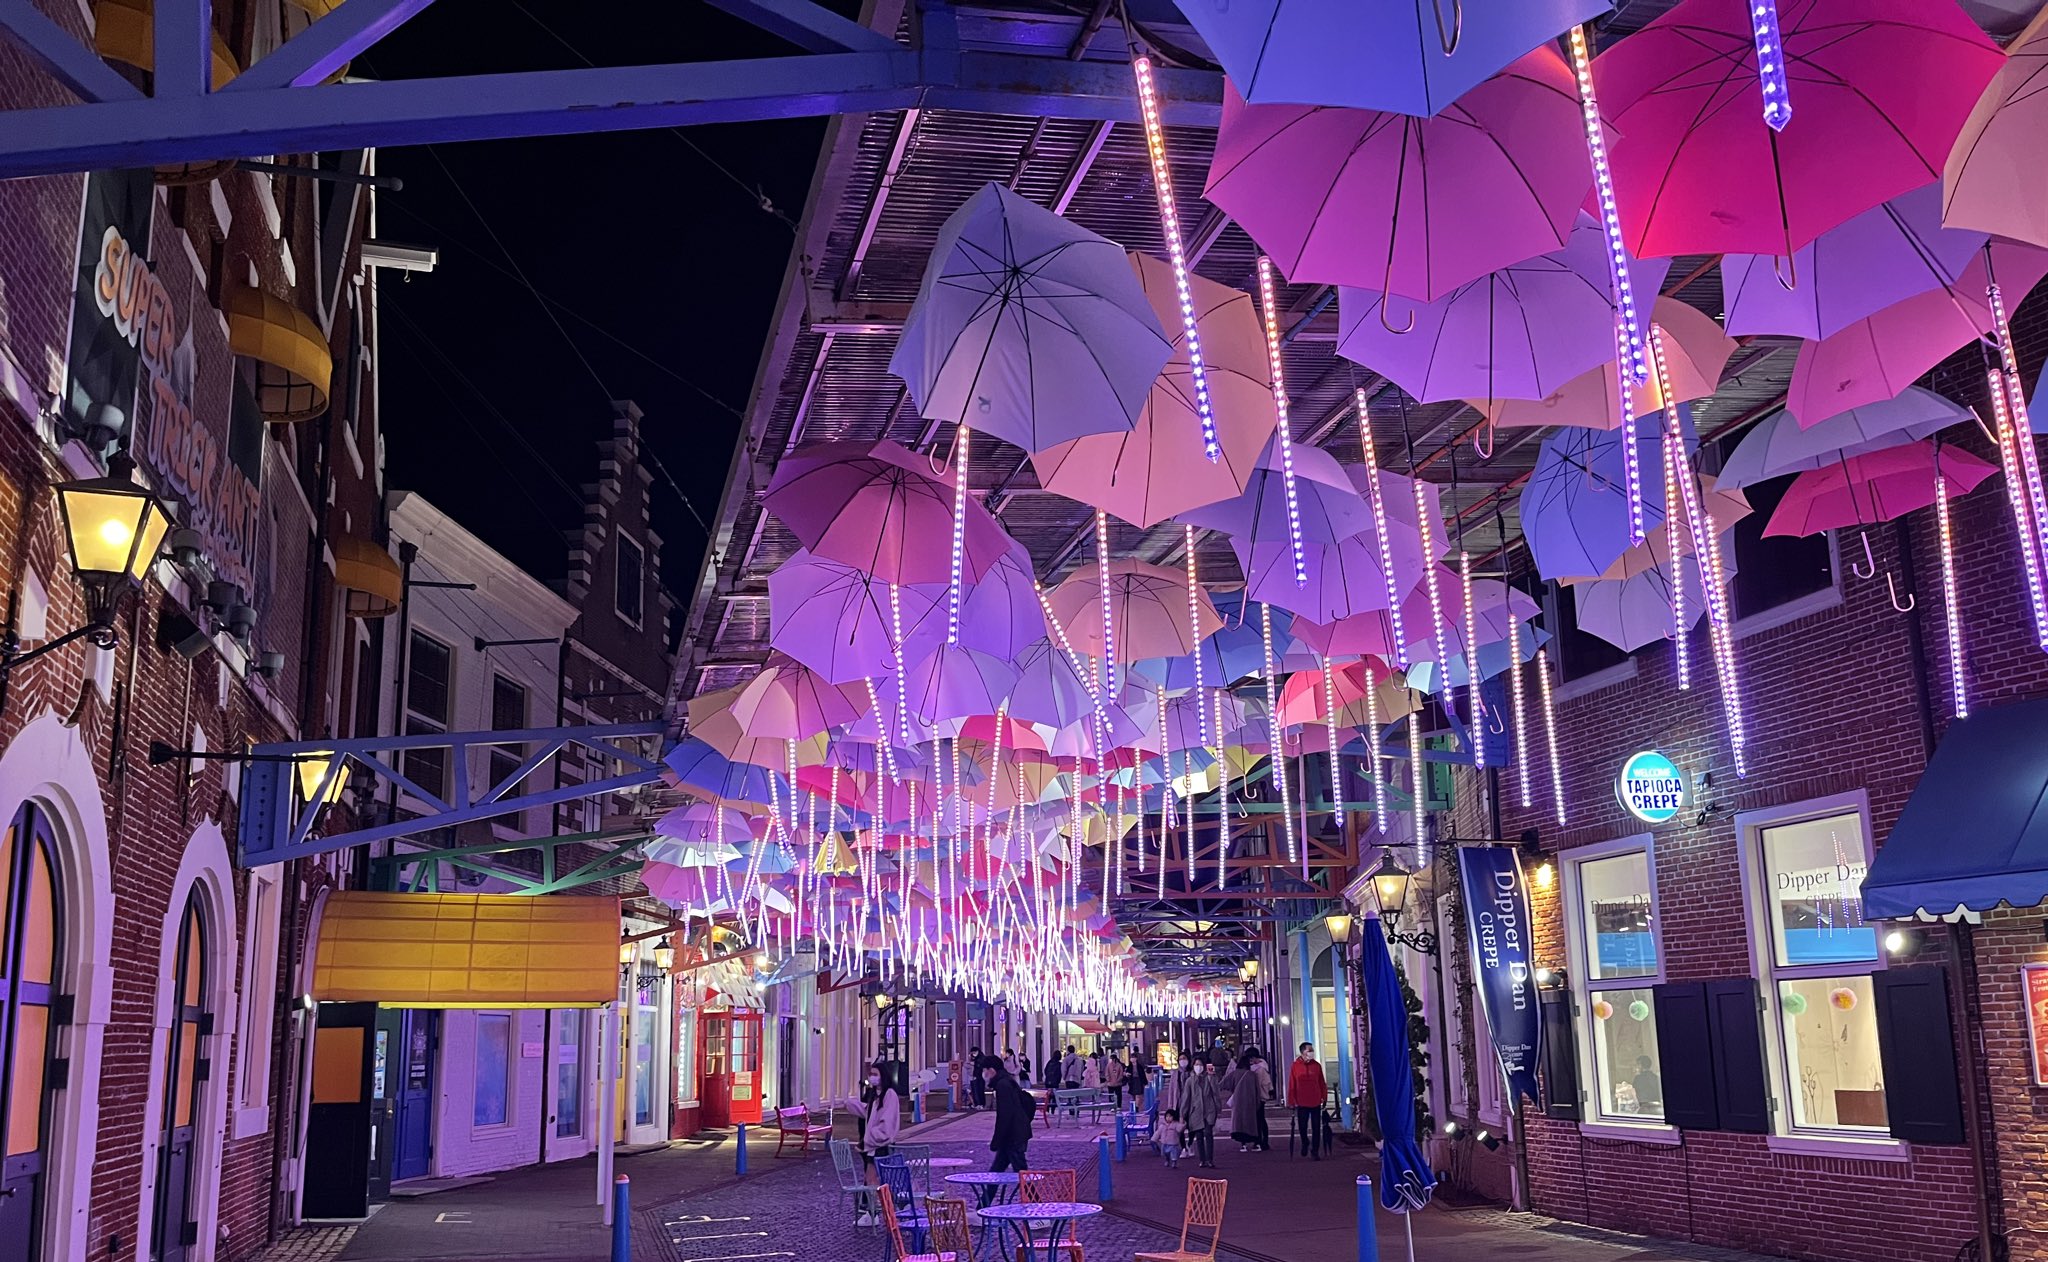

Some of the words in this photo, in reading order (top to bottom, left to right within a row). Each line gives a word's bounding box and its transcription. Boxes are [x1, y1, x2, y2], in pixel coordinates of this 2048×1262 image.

[97, 231, 175, 378] SUPER
[149, 376, 217, 513] TRICK
[217, 461, 262, 562] ART
[1633, 767, 1672, 777] WELCOME
[1627, 778, 1683, 794] TAPIOCA
[1632, 794, 1679, 809] CREPE
[1776, 872, 1830, 892] Dipper
[1633, 894, 1649, 910] Da
[1805, 892, 1842, 907] CREPE
[1479, 911, 1499, 969] CREPE
[1494, 870, 1521, 952] Dipper
[1509, 961, 1528, 1011] Dan
